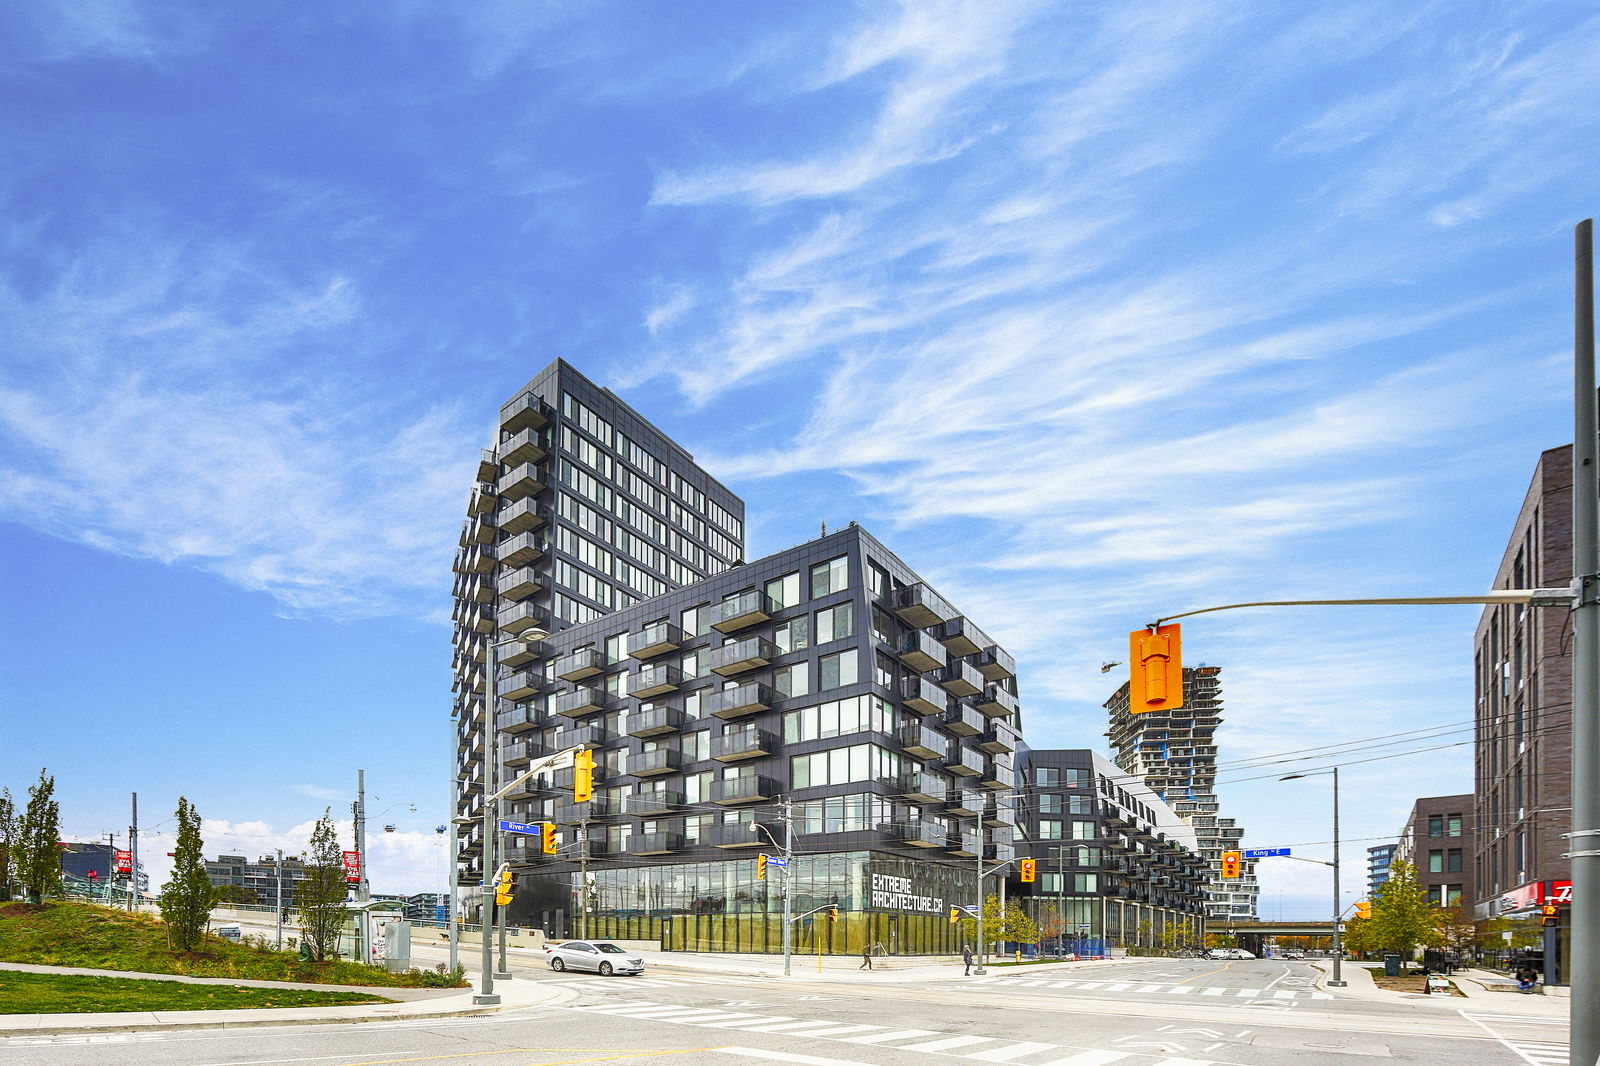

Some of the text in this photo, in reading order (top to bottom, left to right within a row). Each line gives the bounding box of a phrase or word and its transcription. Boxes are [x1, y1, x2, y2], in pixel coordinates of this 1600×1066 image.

[508, 823, 525, 831] River
[872, 874, 911, 893] EXTREME
[872, 891, 942, 912] ARCHITECTURE.CA
